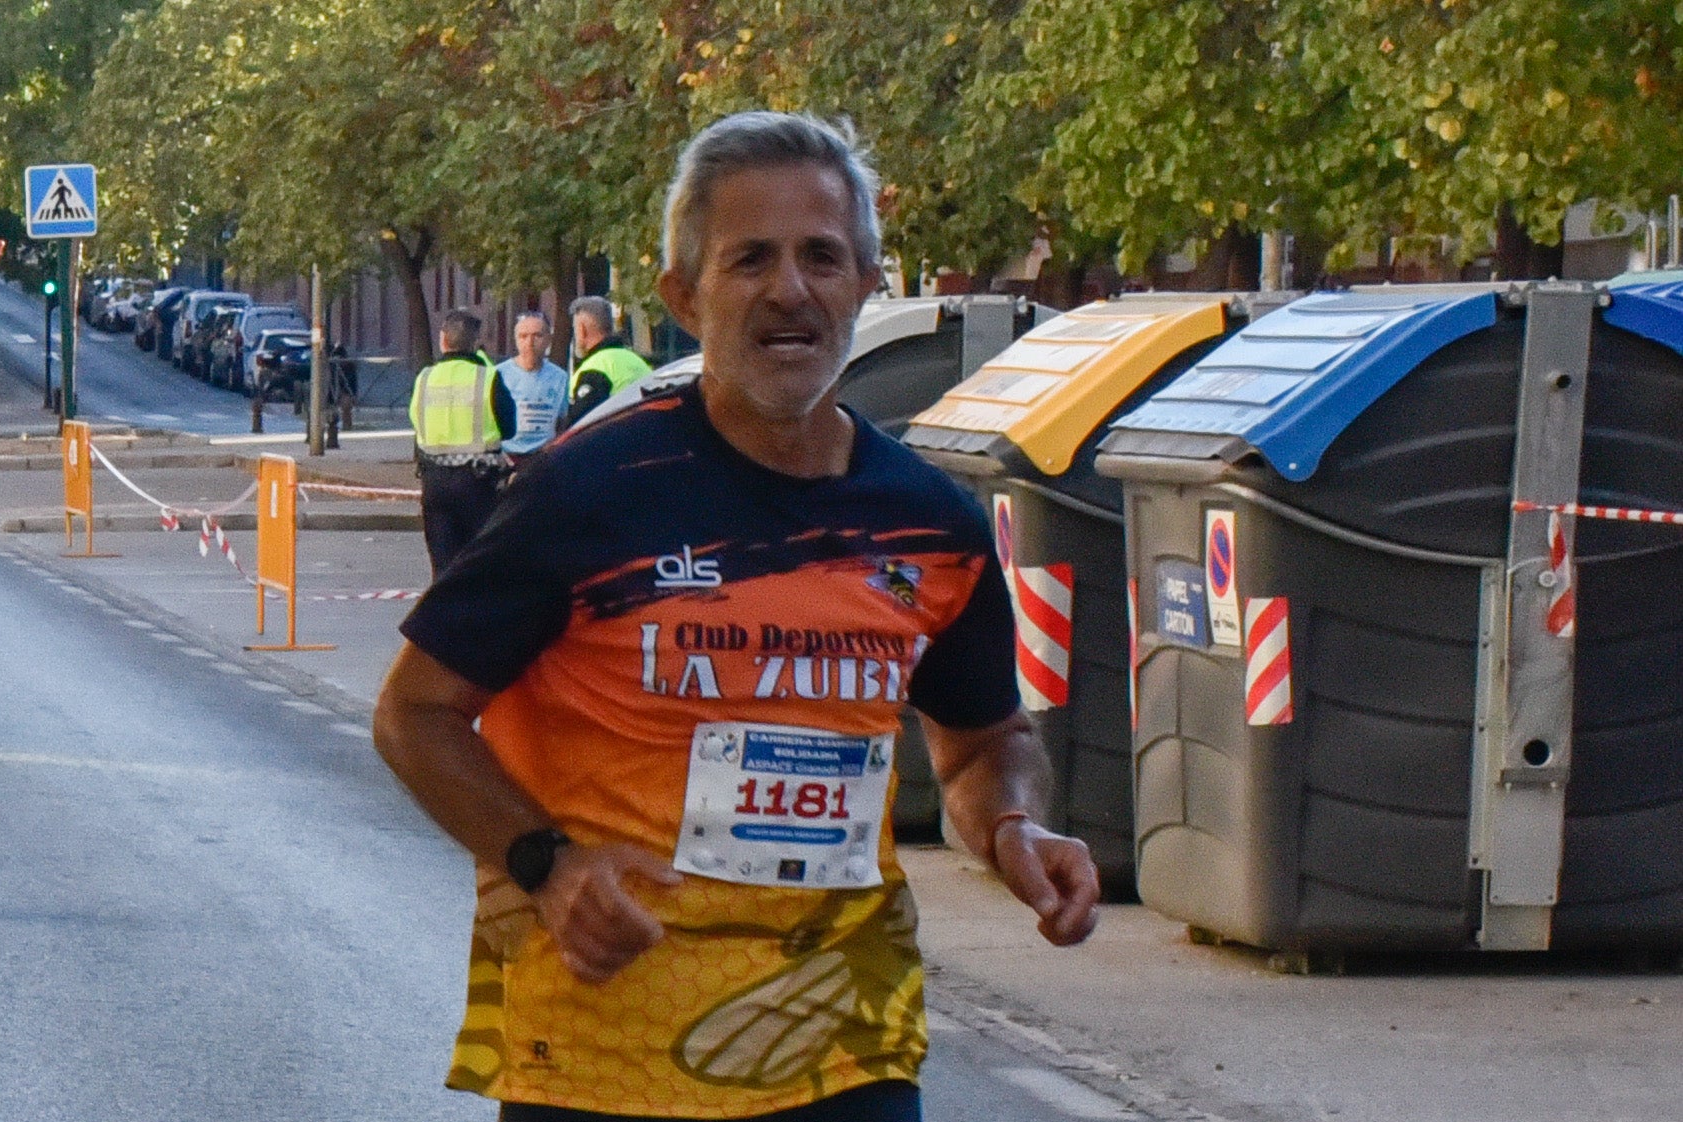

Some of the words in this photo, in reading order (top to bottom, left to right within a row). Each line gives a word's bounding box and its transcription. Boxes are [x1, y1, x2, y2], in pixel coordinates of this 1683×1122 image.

[655, 545, 723, 588] als
[675, 621, 749, 651] Club
[760, 623, 906, 657] Deportivo
[640, 622, 722, 700] LA
[734, 778, 850, 819] 1181
